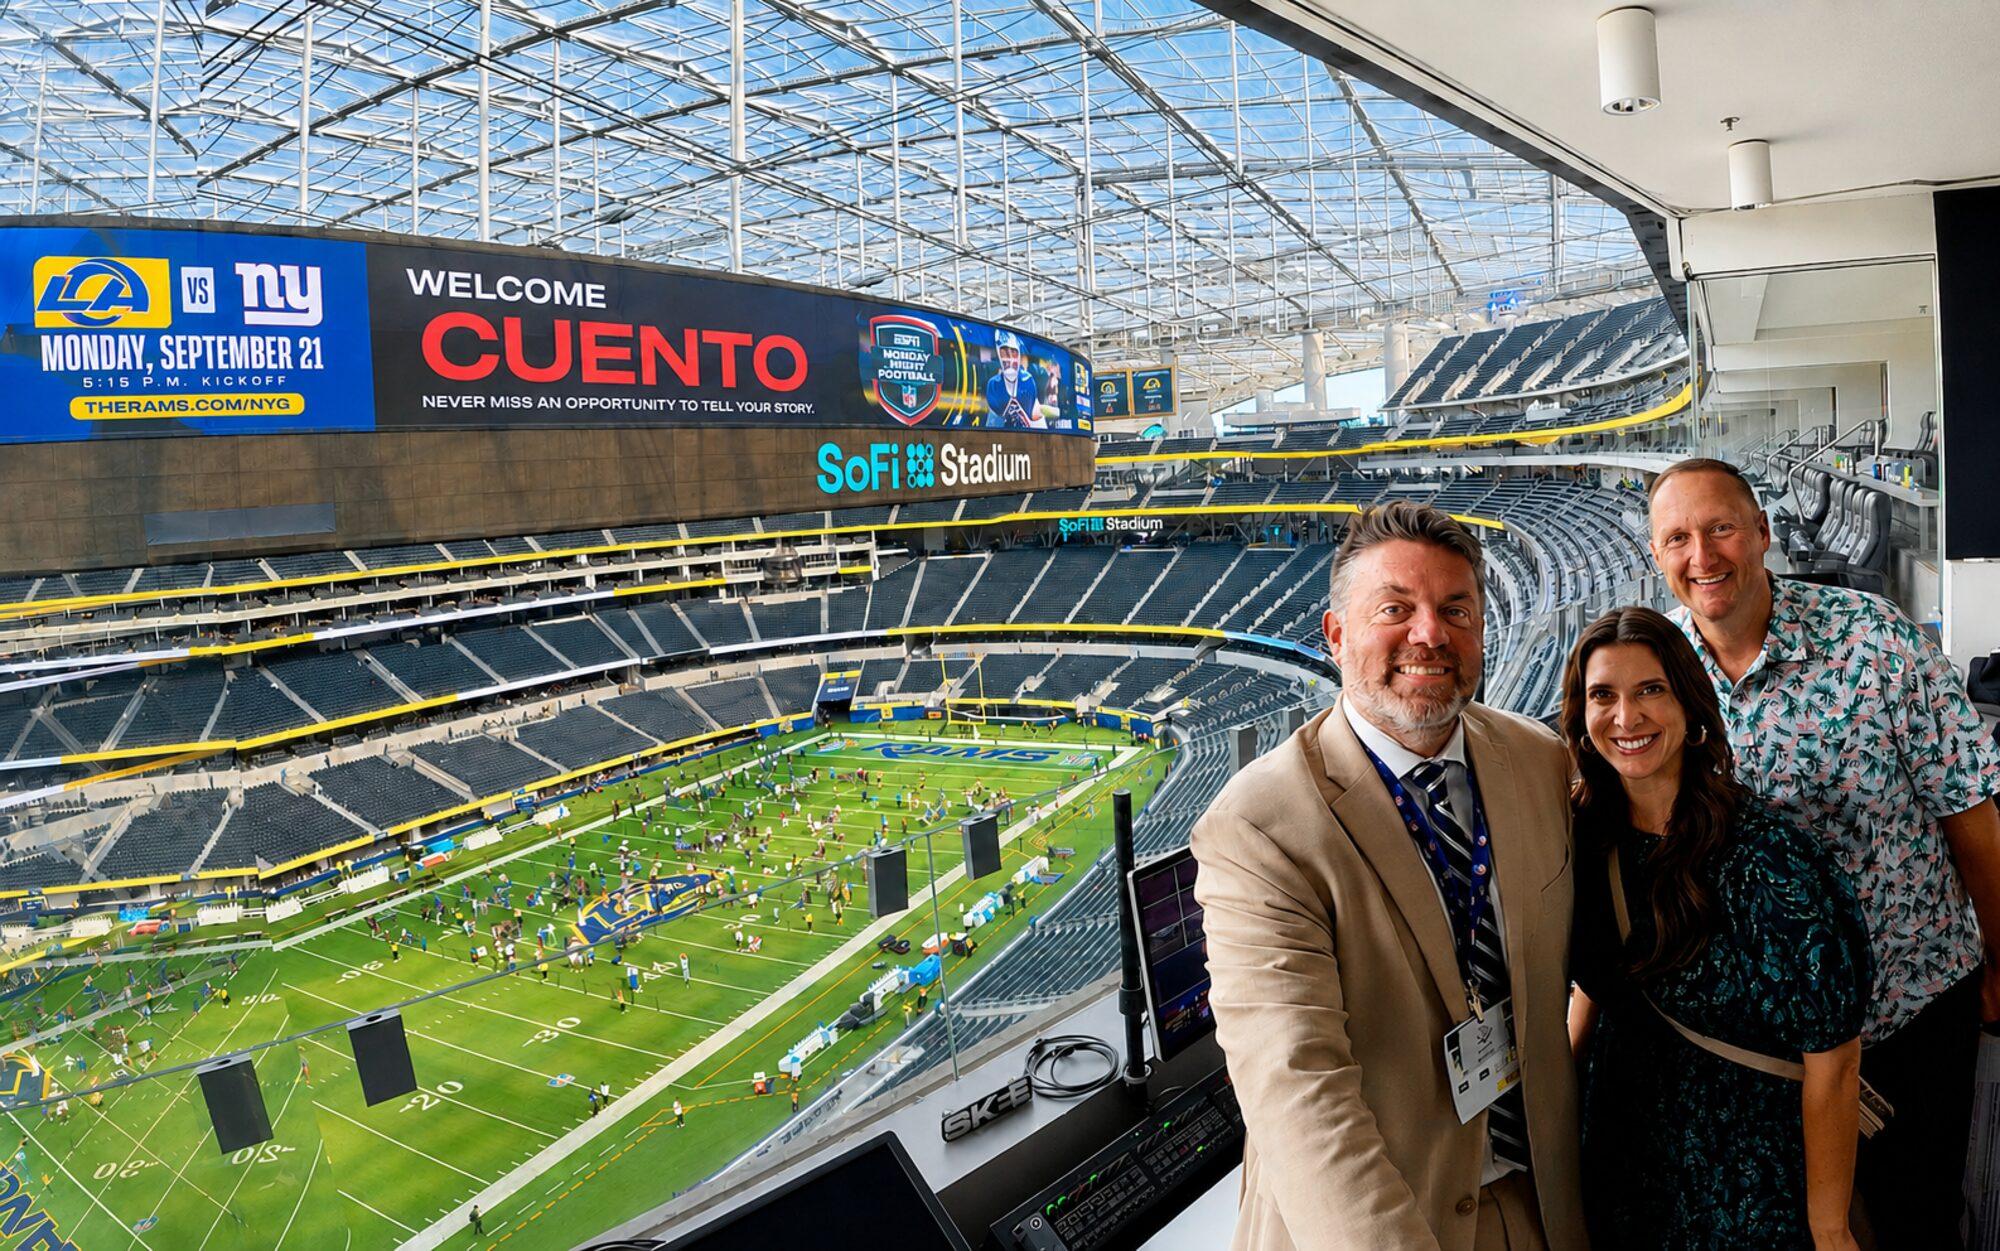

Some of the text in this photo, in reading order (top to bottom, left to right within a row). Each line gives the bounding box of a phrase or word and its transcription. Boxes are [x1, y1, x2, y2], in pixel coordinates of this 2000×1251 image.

[187, 276, 209, 304] VS
[406, 268, 607, 309] WELCOME
[40, 334, 324, 375] MONDAY, SEPTEMBER 21
[421, 311, 809, 392] CUENTO
[82, 375, 287, 388] 5:15 P.M. KICKOFF
[84, 398, 291, 414] THERAMS.COM/NYG
[422, 395, 815, 415] NEVER MISS AN OPPORTUNITY TO TELL YOUR STORY.
[816, 441, 1032, 494] SoFi Stadium
[1106, 516, 1164, 531] Stadium
[534, 1016, 582, 1044] 30
[410, 1080, 464, 1111] 20
